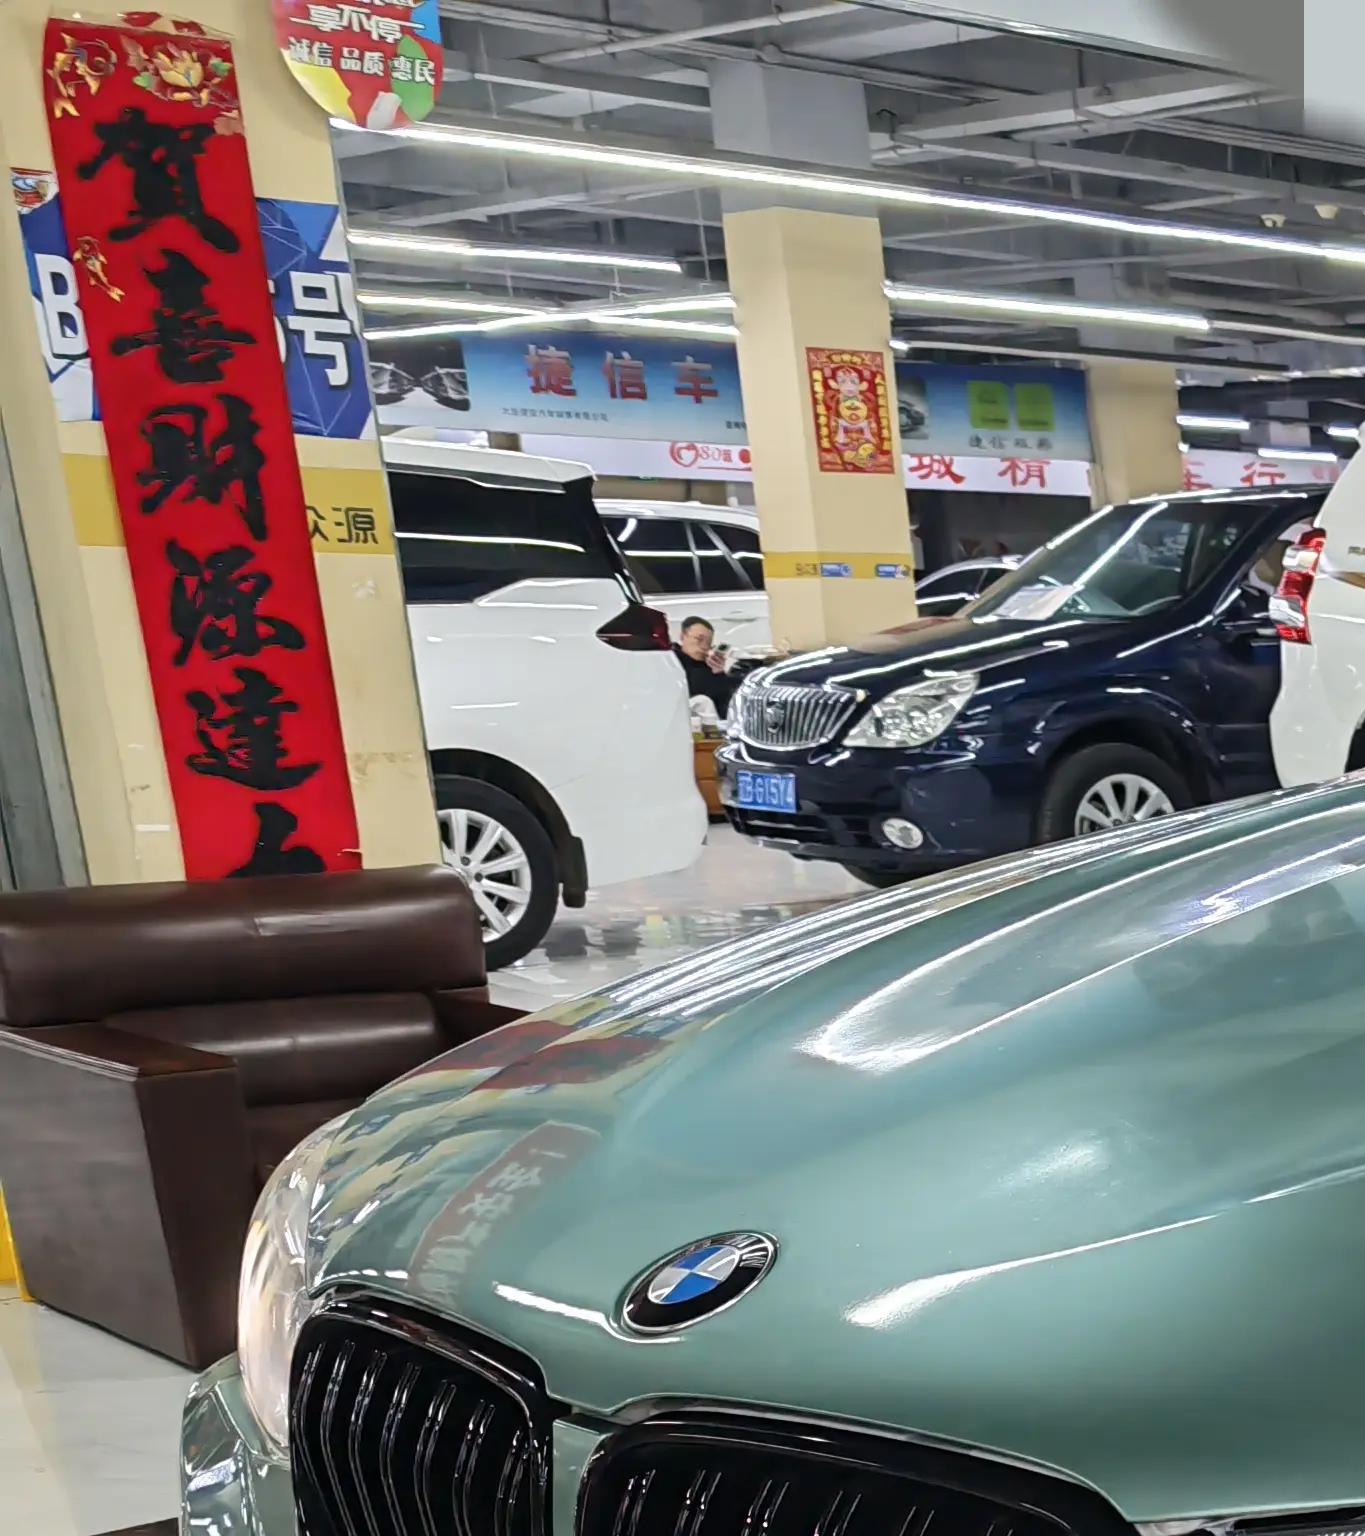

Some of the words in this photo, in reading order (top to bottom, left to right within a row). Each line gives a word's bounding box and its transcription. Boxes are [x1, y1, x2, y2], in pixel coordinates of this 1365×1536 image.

[289, 4, 425, 43] 享不停
[288, 36, 333, 67] 诚信
[340, 47, 385, 77] 品质
[390, 57, 436, 85] 惠民
